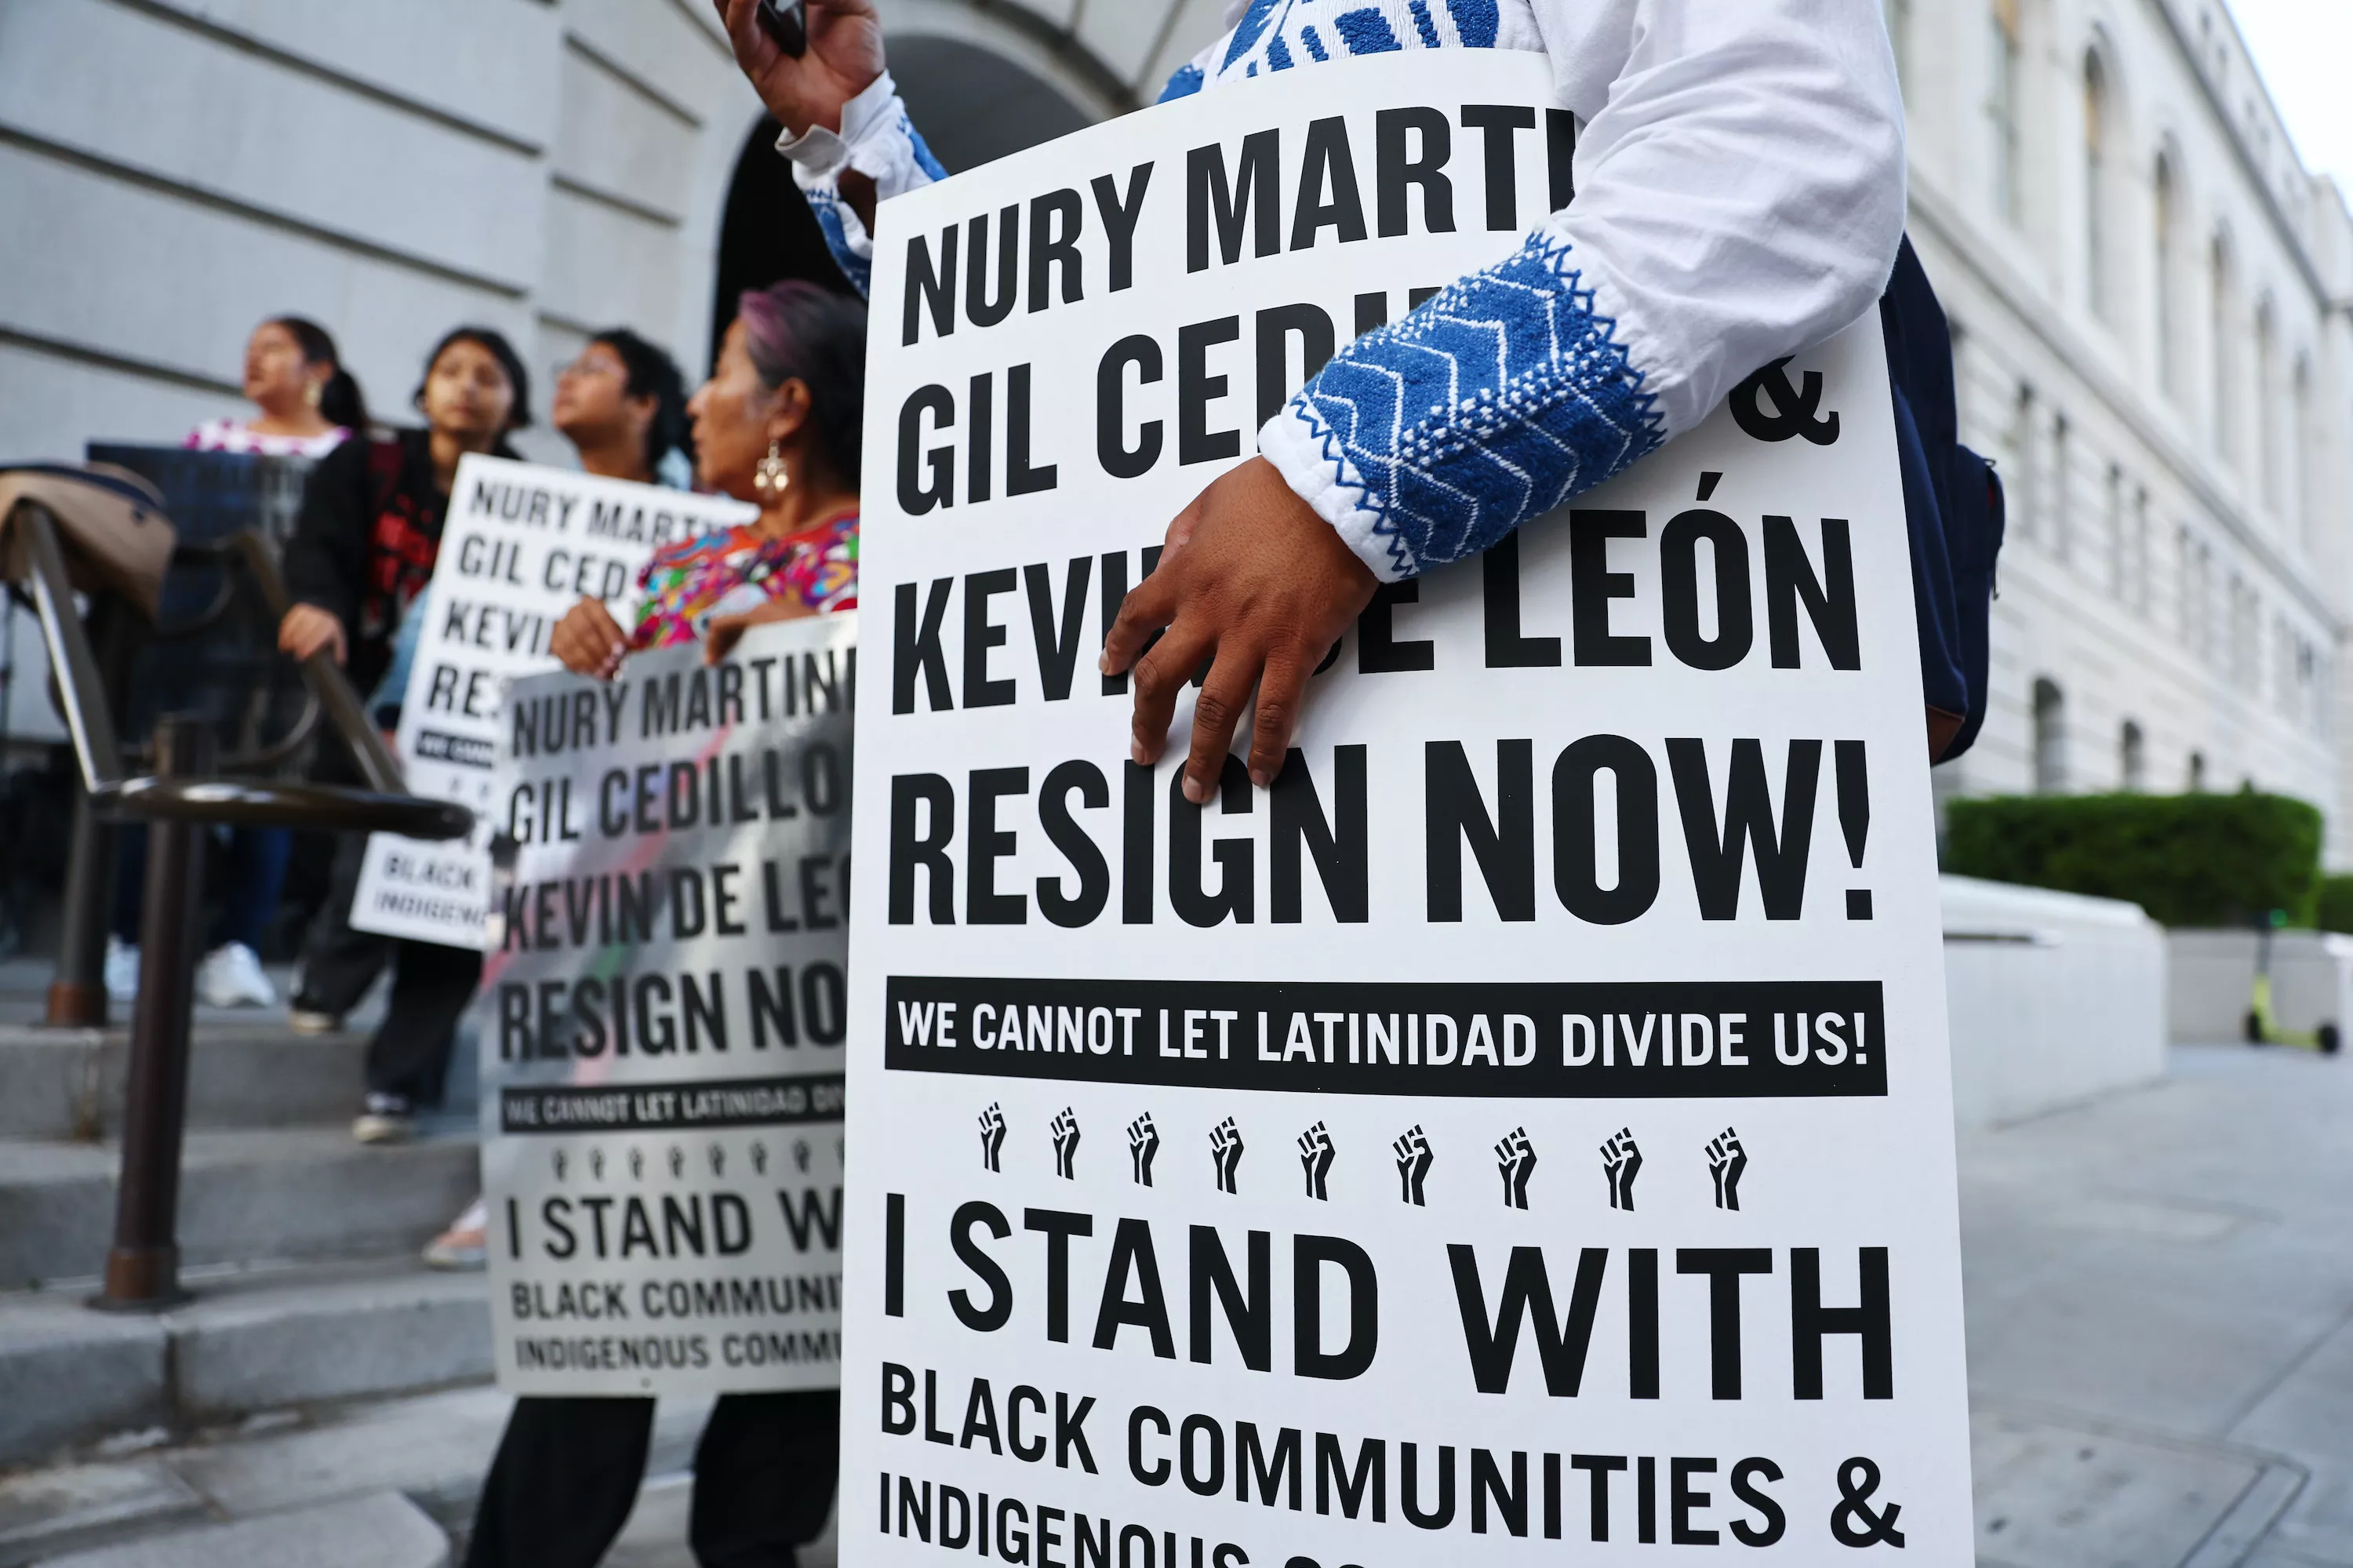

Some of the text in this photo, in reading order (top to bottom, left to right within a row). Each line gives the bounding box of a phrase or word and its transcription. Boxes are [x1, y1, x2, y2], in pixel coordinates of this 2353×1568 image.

[902, 161, 1155, 347] NURY
[896, 287, 1840, 516] GIL CED &
[471, 480, 579, 530] NURY
[458, 533, 525, 584] GIL
[893, 545, 1215, 715] KEVI
[1482, 471, 1861, 671] LEÓN
[429, 666, 499, 719] RE
[511, 682, 630, 758] NURY
[510, 741, 845, 845] GIL CEDILLO
[888, 734, 1873, 928] RESIGN NOW!
[504, 855, 850, 952] KEVIN DE LE
[500, 969, 729, 1063] RESIGN
[898, 1001, 1867, 1067] WE CANNOT LET LATINIDAD DIVIDE US!
[542, 1095, 629, 1124] CANNOT
[635, 1090, 677, 1122] LET
[507, 1195, 520, 1259] I
[541, 1191, 753, 1260] STAND
[511, 1271, 843, 1321] BLACK COMMUNI
[885, 1192, 1893, 1401] I STAND WITH
[515, 1336, 711, 1371] INDIGENOUS
[882, 1361, 1905, 1549] BLACK COMMUNITIES &
